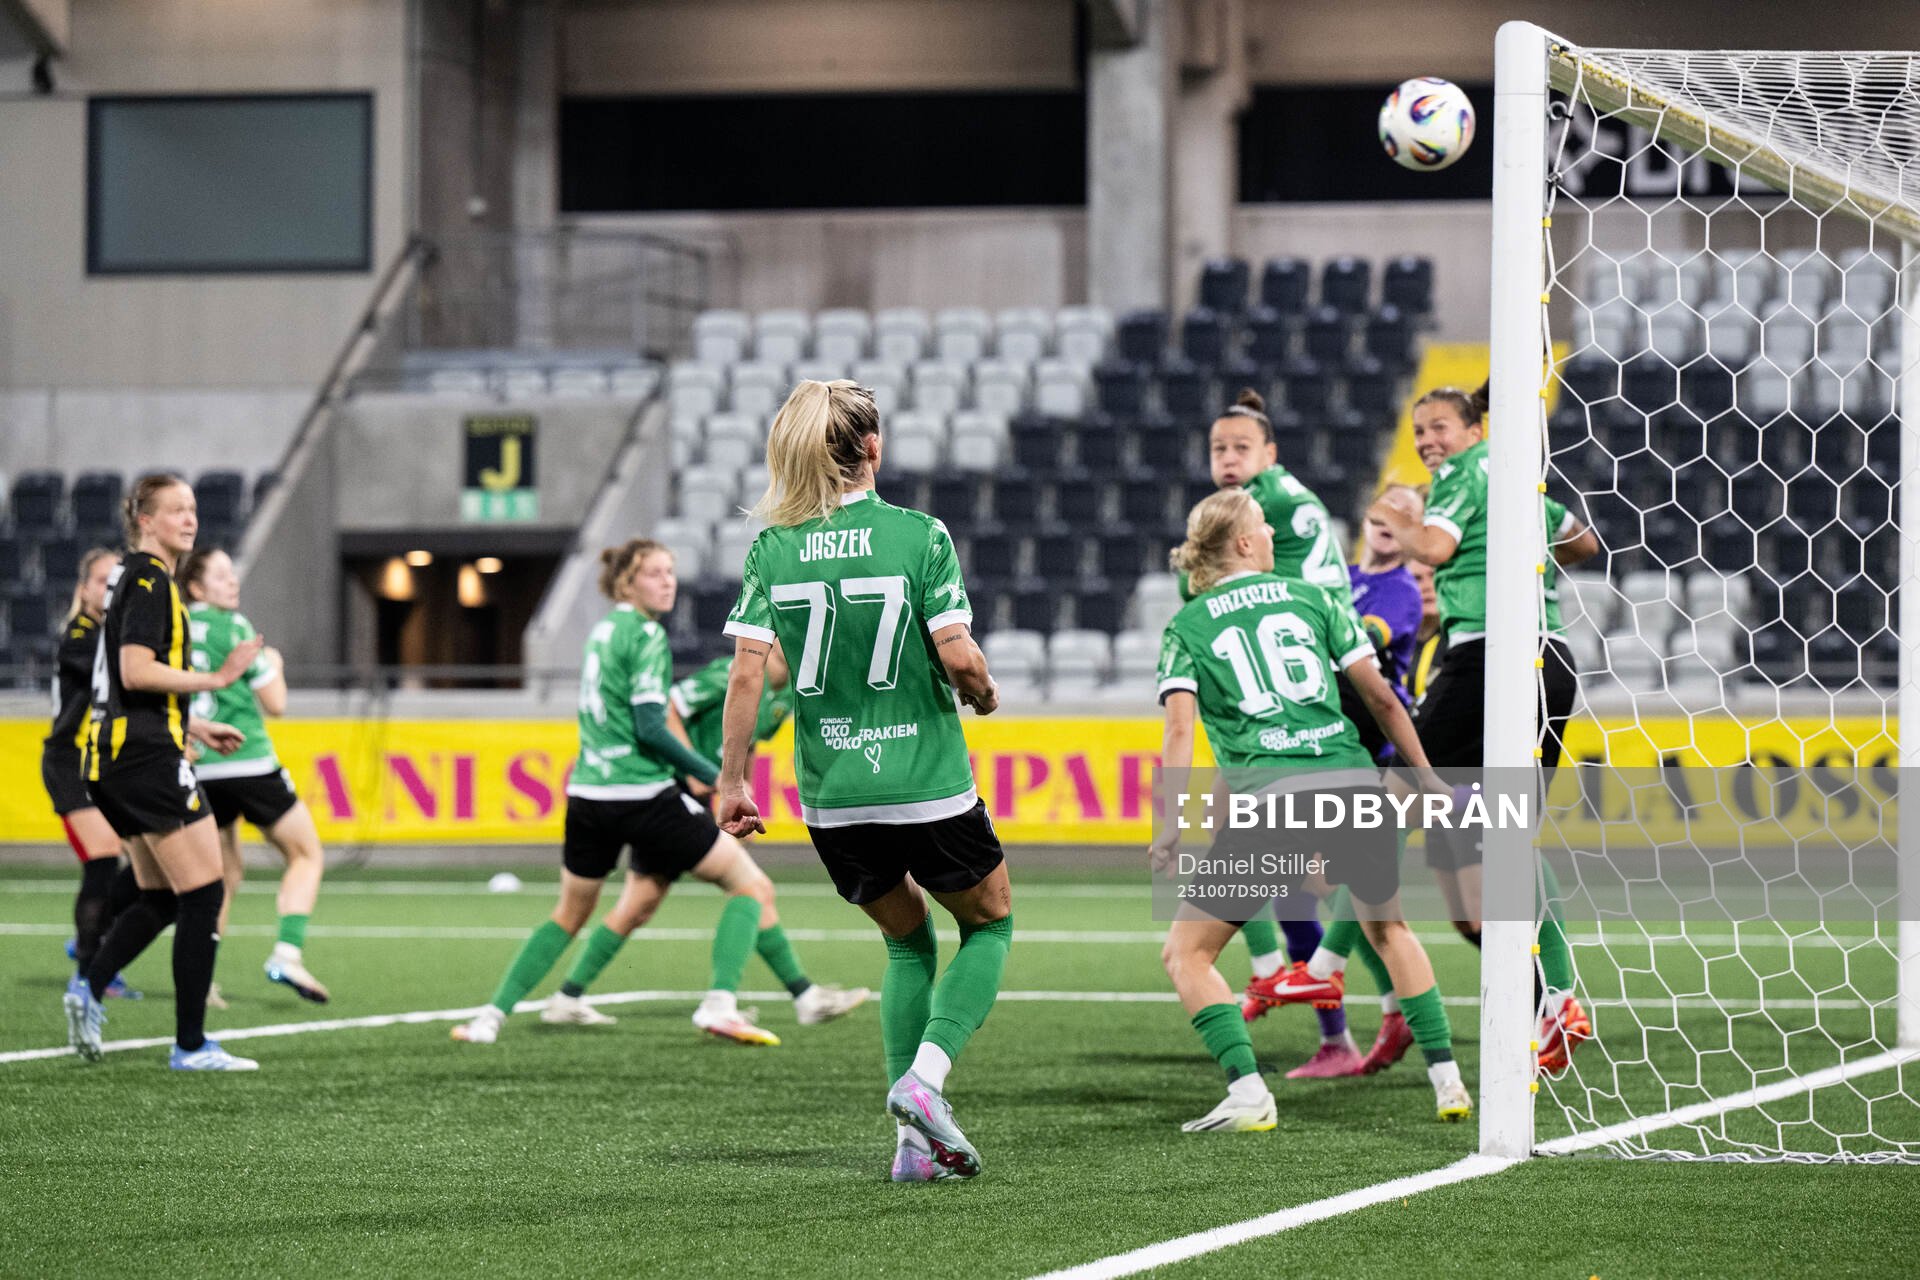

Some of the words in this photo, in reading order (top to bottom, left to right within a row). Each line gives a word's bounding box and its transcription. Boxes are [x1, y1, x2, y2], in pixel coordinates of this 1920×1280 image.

[480, 437, 521, 491] J
[800, 528, 873, 562] JASZEK
[771, 576, 912, 697] 77
[1211, 612, 1328, 718] 16
[821, 725, 850, 738] OKO
[505, 752, 575, 821] S
